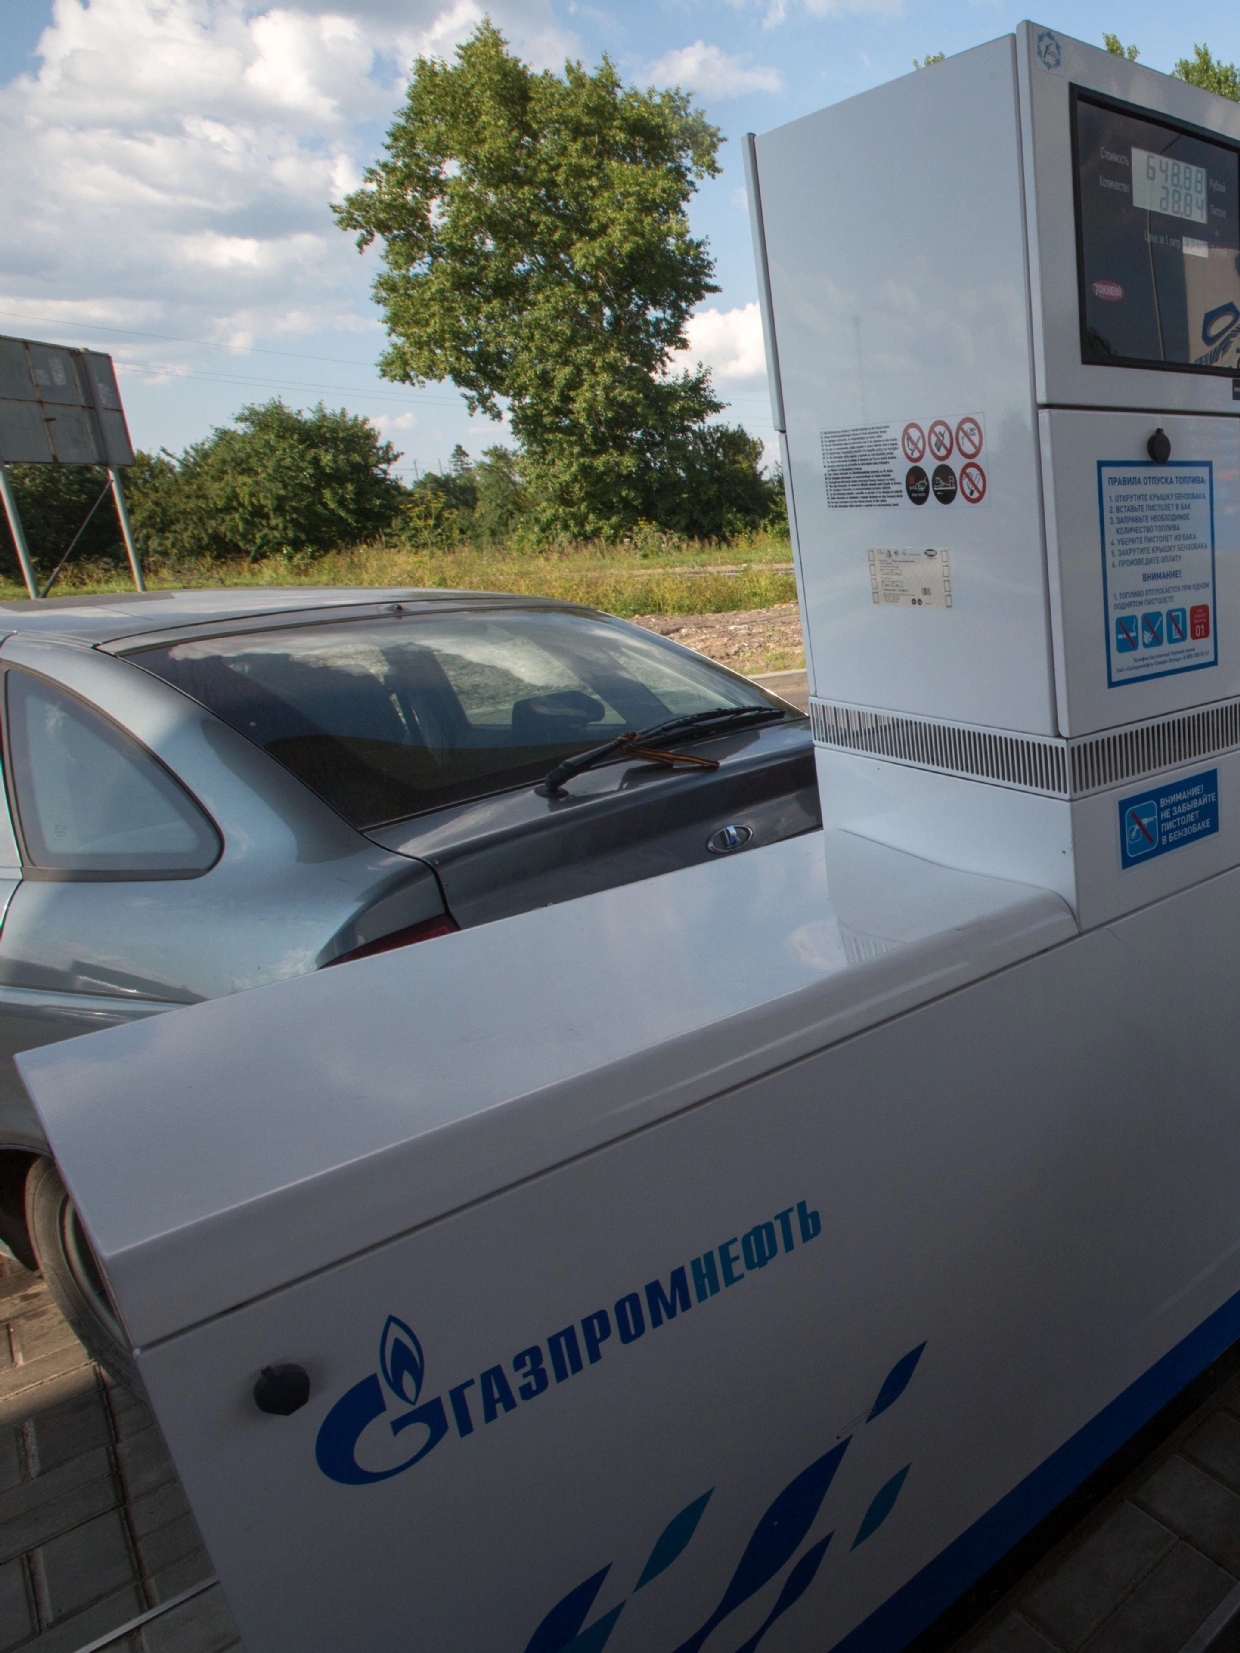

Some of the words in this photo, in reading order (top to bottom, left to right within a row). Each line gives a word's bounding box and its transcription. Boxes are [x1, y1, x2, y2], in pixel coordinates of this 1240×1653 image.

[1100, 146, 1130, 166] Стоимость
[1099, 175, 1130, 194] Количество
[1144, 230, 1158, 244] Цена
[1091, 283, 1122, 298] TOKHEIM
[1108, 476, 1142, 486] ПРАВИЛА
[1143, 476, 1173, 486] ОТПУСКА
[1175, 476, 1207, 485] ТОПЛИВА:
[1115, 494, 1148, 503] ОТКРУТИТЕ
[1149, 493, 1174, 501] КРЫШКУ
[1174, 492, 1206, 500] БЕНЗОБАКА
[1115, 505, 1145, 513] ВСТАВЬТЕ
[1146, 503, 1175, 512] ПИСТОЛЕТ
[1116, 515, 1149, 524] ЗАПРАВЬТЕ
[1150, 513, 1190, 522] НЕОБХОДИМОЕ
[1116, 526, 1154, 535] КОЛИЧЕСТВО
[1155, 524, 1180, 533] ТОПЛИВА
[1117, 537, 1143, 546] УБЕРИТЕ
[1144, 534, 1173, 544] ПИСТОЛЕТ
[1182, 533, 1197, 541] БАКА
[1117, 547, 1151, 557] ЗАКРУТИТЕ
[1152, 544, 1176, 554] КРЫШКУ
[1177, 543, 1208, 552] БЕНЗОБАКА
[1118, 557, 1160, 568] ПРОИЗВЕДИТЕ
[1161, 555, 1182, 564] ОПЛАТУ
[1142, 569, 1182, 582] ВНИМАНИЕ!
[1118, 591, 1144, 600] ТОПЛИВО
[1145, 585, 1181, 597] ОТПУСКАЕТСЯ
[1181, 584, 1192, 592] ПРИ
[1192, 582, 1209, 591] ОДНОМ
[1114, 601, 1144, 610] ПОДНЯТОМ
[1144, 596, 1174, 606] ПИСТОЛЕТЕ
[1195, 624, 1205, 637] 01
[1160, 784, 1204, 807] ВНИМАНИЕ!
[1160, 809, 1171, 820] НЕ
[1172, 792, 1216, 816] ЗАБЫВАЙТЕ
[1161, 811, 1199, 833] ПИСТОЛЕТ
[1162, 836, 1167, 845] В
[1169, 819, 1211, 842] БЕНЗОБАКЕ
[448, 1199, 822, 1439] ГАЗПРОМНЕФТЬ
